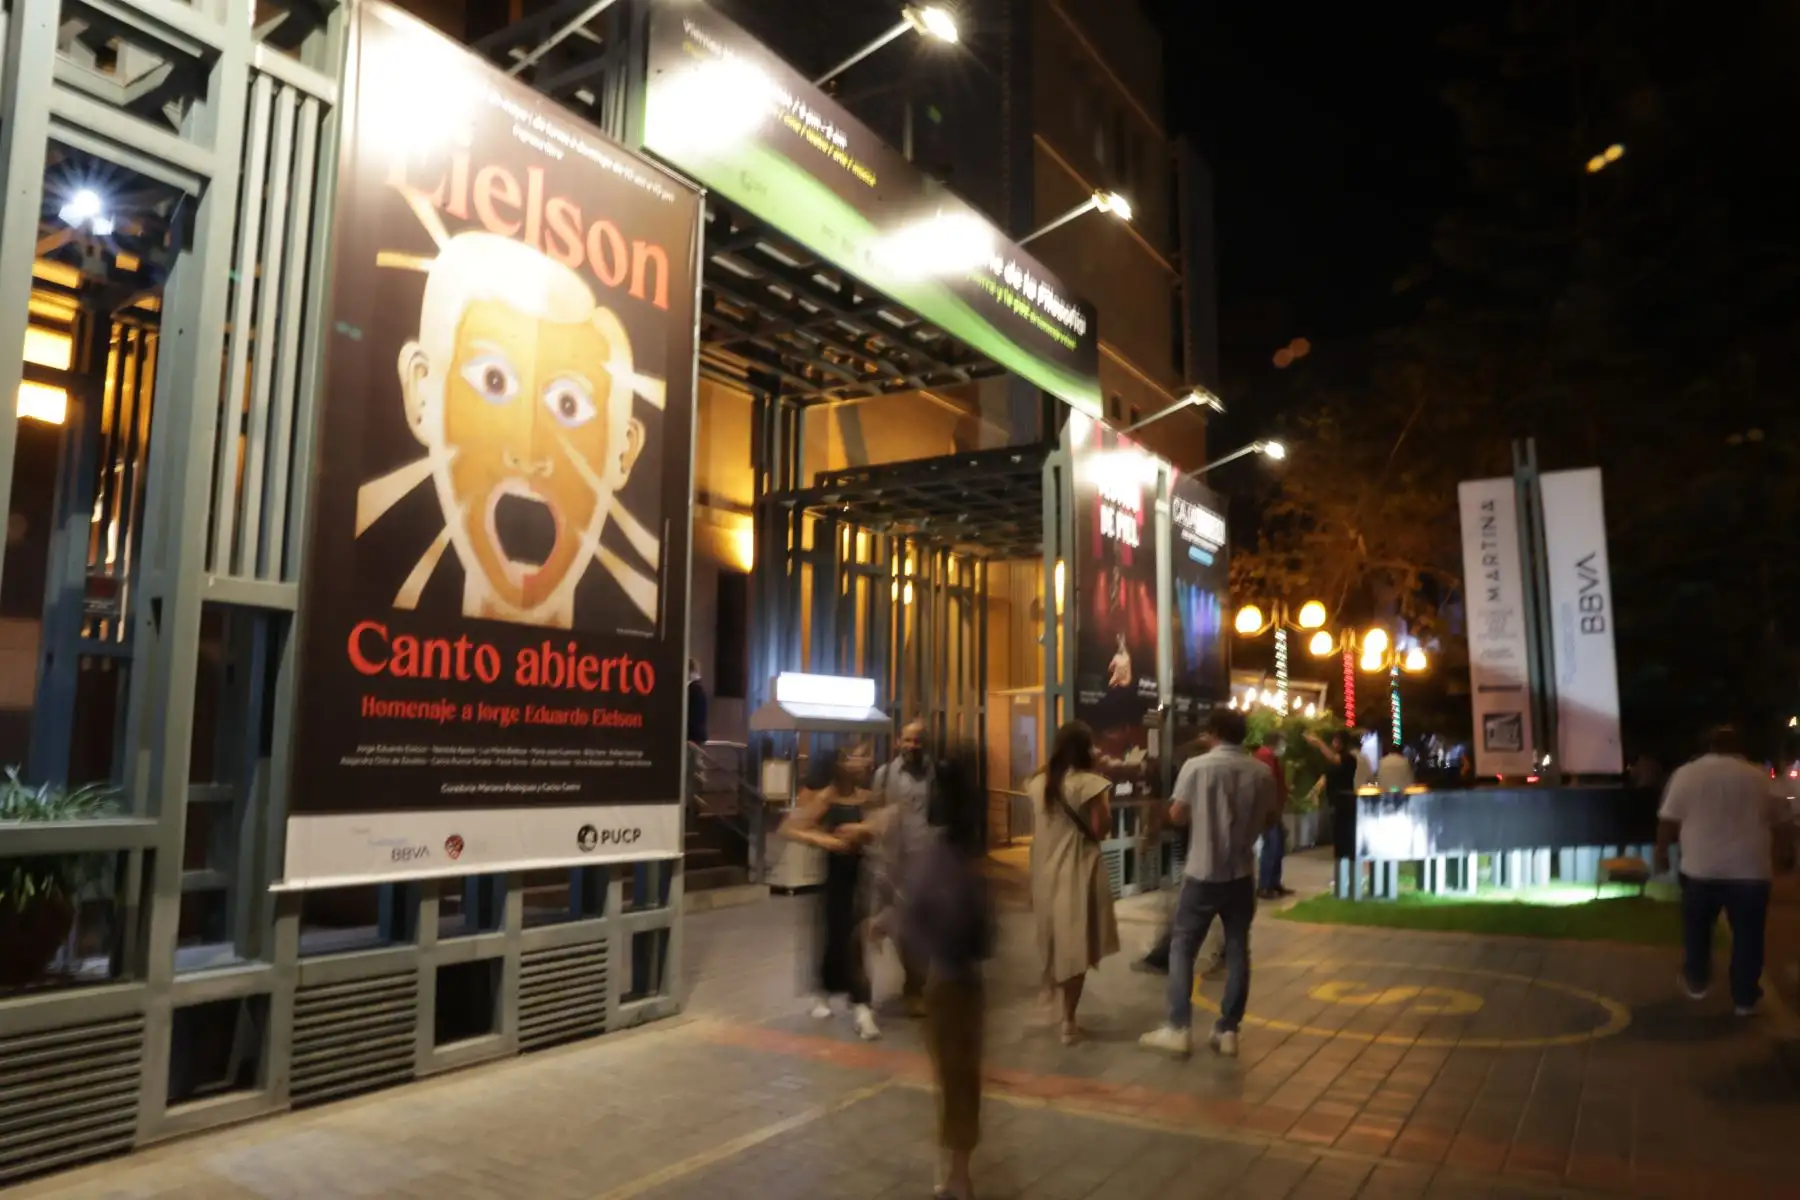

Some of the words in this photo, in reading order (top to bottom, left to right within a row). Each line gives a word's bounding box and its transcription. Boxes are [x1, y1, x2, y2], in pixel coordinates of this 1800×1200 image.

[1480, 499, 1500, 604] MARTINA
[1575, 551, 1606, 636] BBVA
[346, 619, 502, 685] Canto
[514, 640, 656, 696] abierto
[360, 695, 457, 726] Homenaje
[461, 703, 473, 722] a
[476, 701, 520, 728] Jorge
[524, 705, 590, 727] Eduardo
[391, 845, 431, 863] BBVA
[601, 827, 642, 846] PUCP
